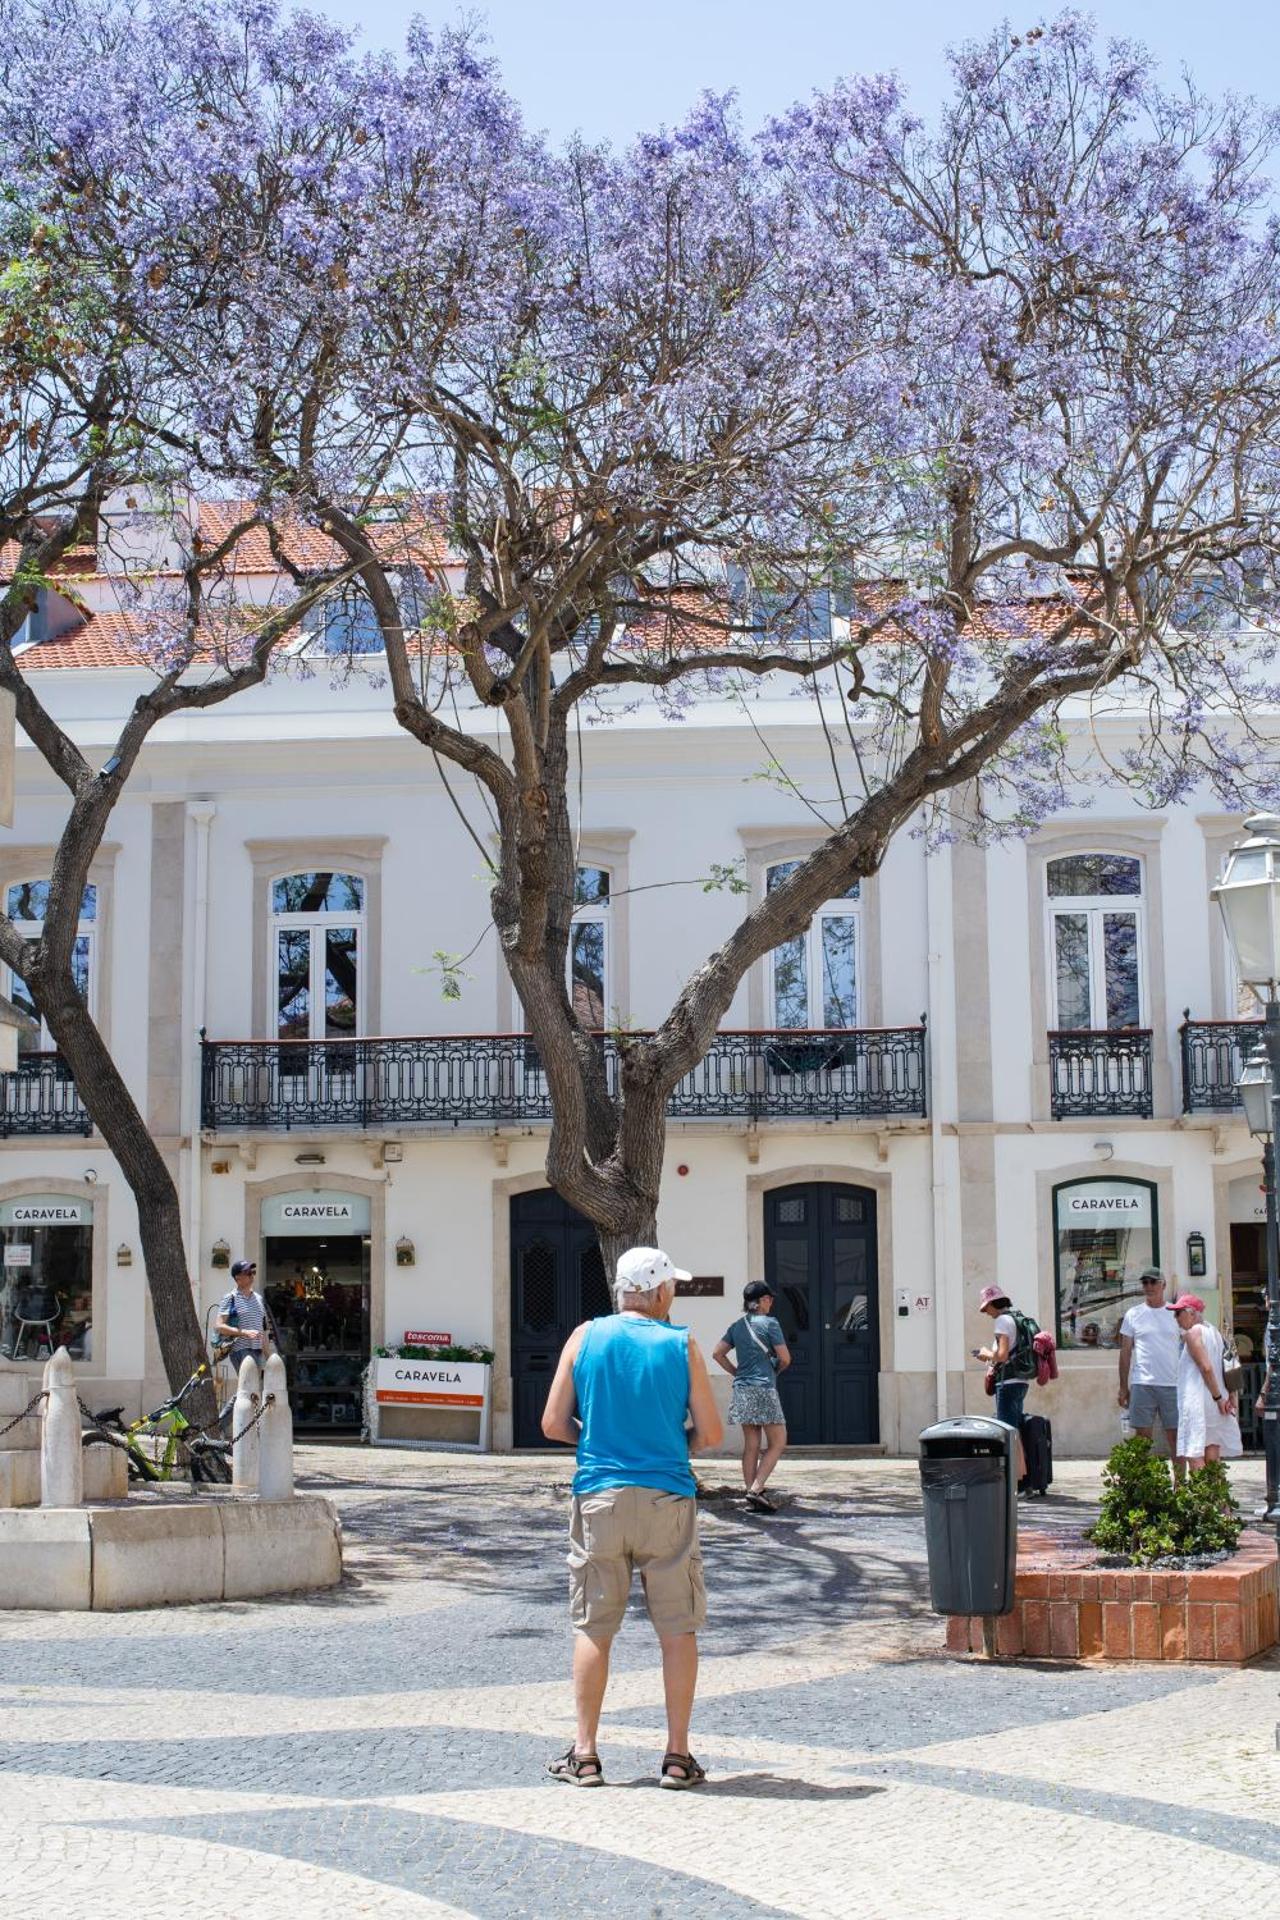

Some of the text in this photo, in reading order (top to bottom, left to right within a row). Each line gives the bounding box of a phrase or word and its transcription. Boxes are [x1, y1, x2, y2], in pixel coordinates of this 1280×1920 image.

[1071, 1199, 1139, 1210] CARAVELA
[14, 1209, 78, 1219] CARAVELA
[284, 1206, 349, 1217] CARAVELA
[915, 1297, 930, 1307] AT
[394, 1370, 462, 1383] CARAVELA
